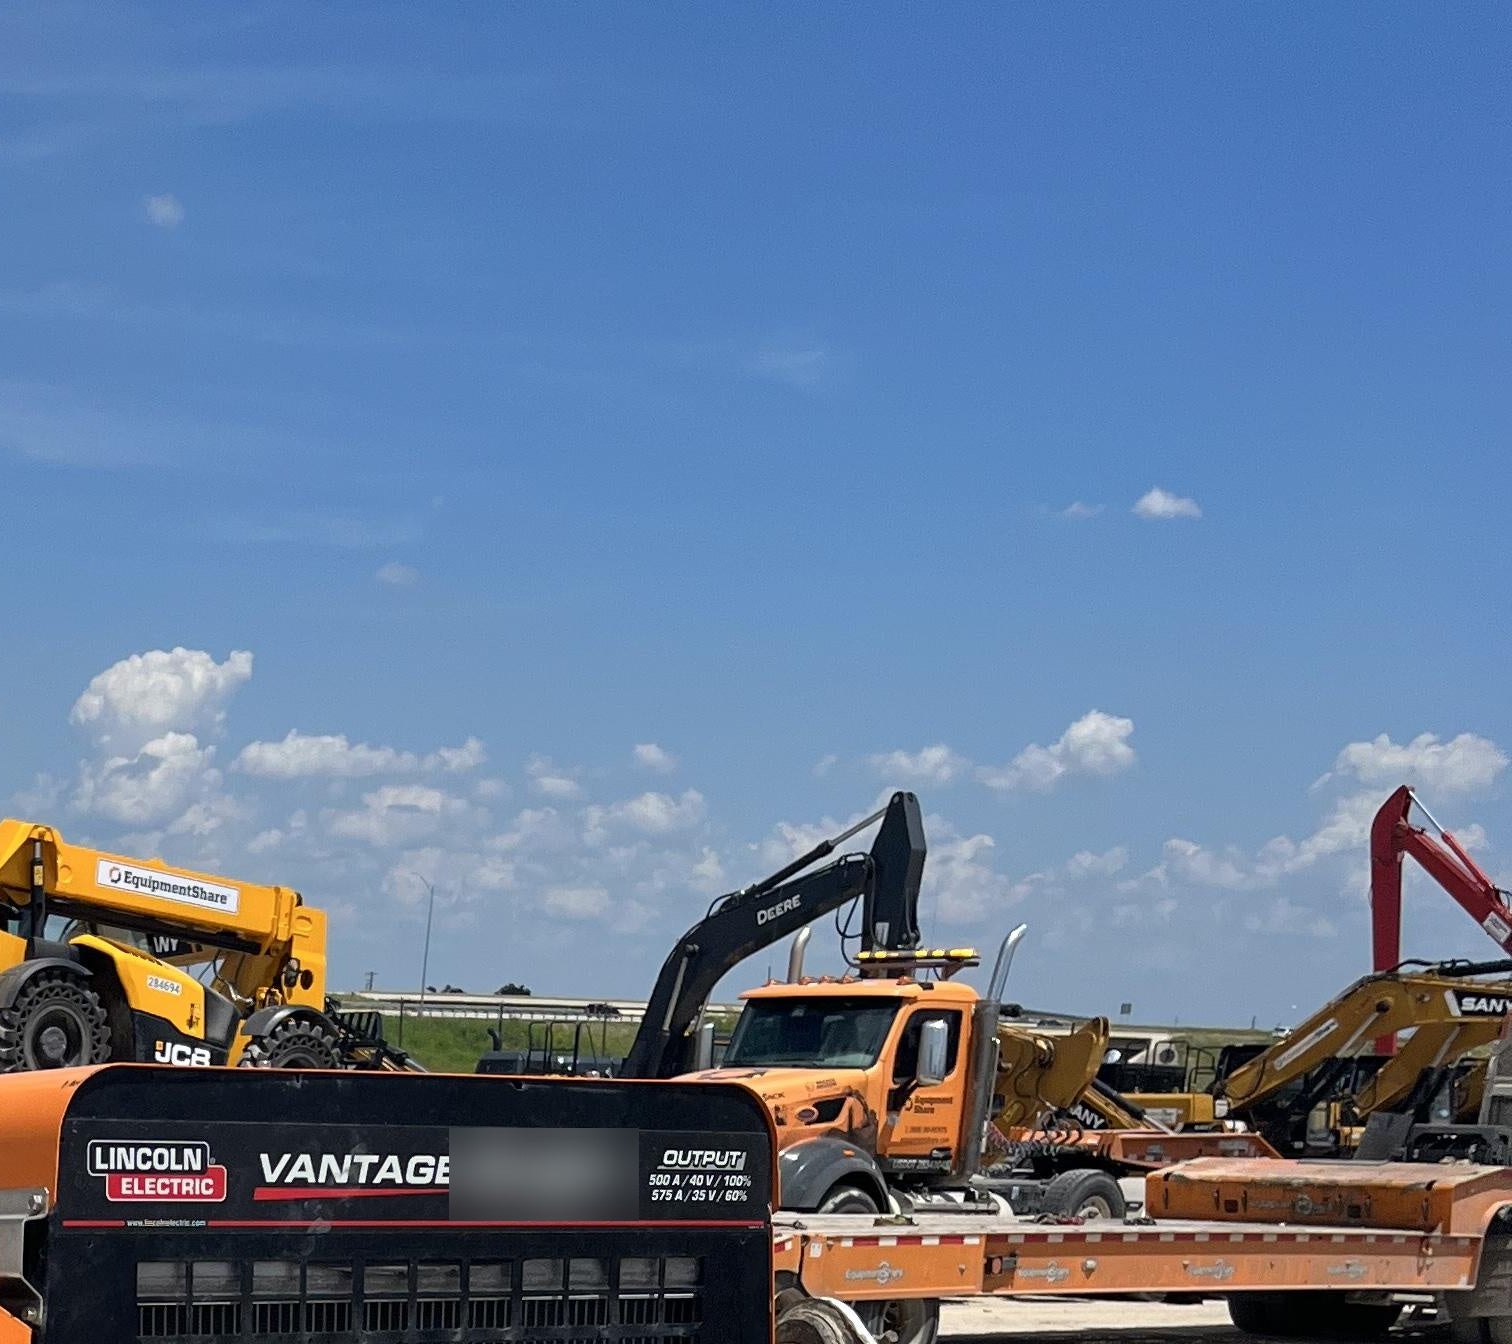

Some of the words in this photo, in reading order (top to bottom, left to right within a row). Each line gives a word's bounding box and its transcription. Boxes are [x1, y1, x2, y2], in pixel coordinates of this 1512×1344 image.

[124, 870, 227, 904] EquipmentShare
[756, 894, 802, 925] DEERE
[148, 977, 180, 993] 284694
[155, 1041, 211, 1067] JCB
[95, 1147, 202, 1171] LINCOLN
[663, 1150, 742, 1166] OUTPUT
[120, 1178, 215, 1196] ELECTRIC
[648, 1174, 670, 1186] 500
[689, 1174, 704, 1187] 40
[723, 1175, 752, 1187] 100%
[651, 1189, 673, 1201] 575
[691, 1190, 706, 1201] 35
[725, 1190, 748, 1202] 60%
